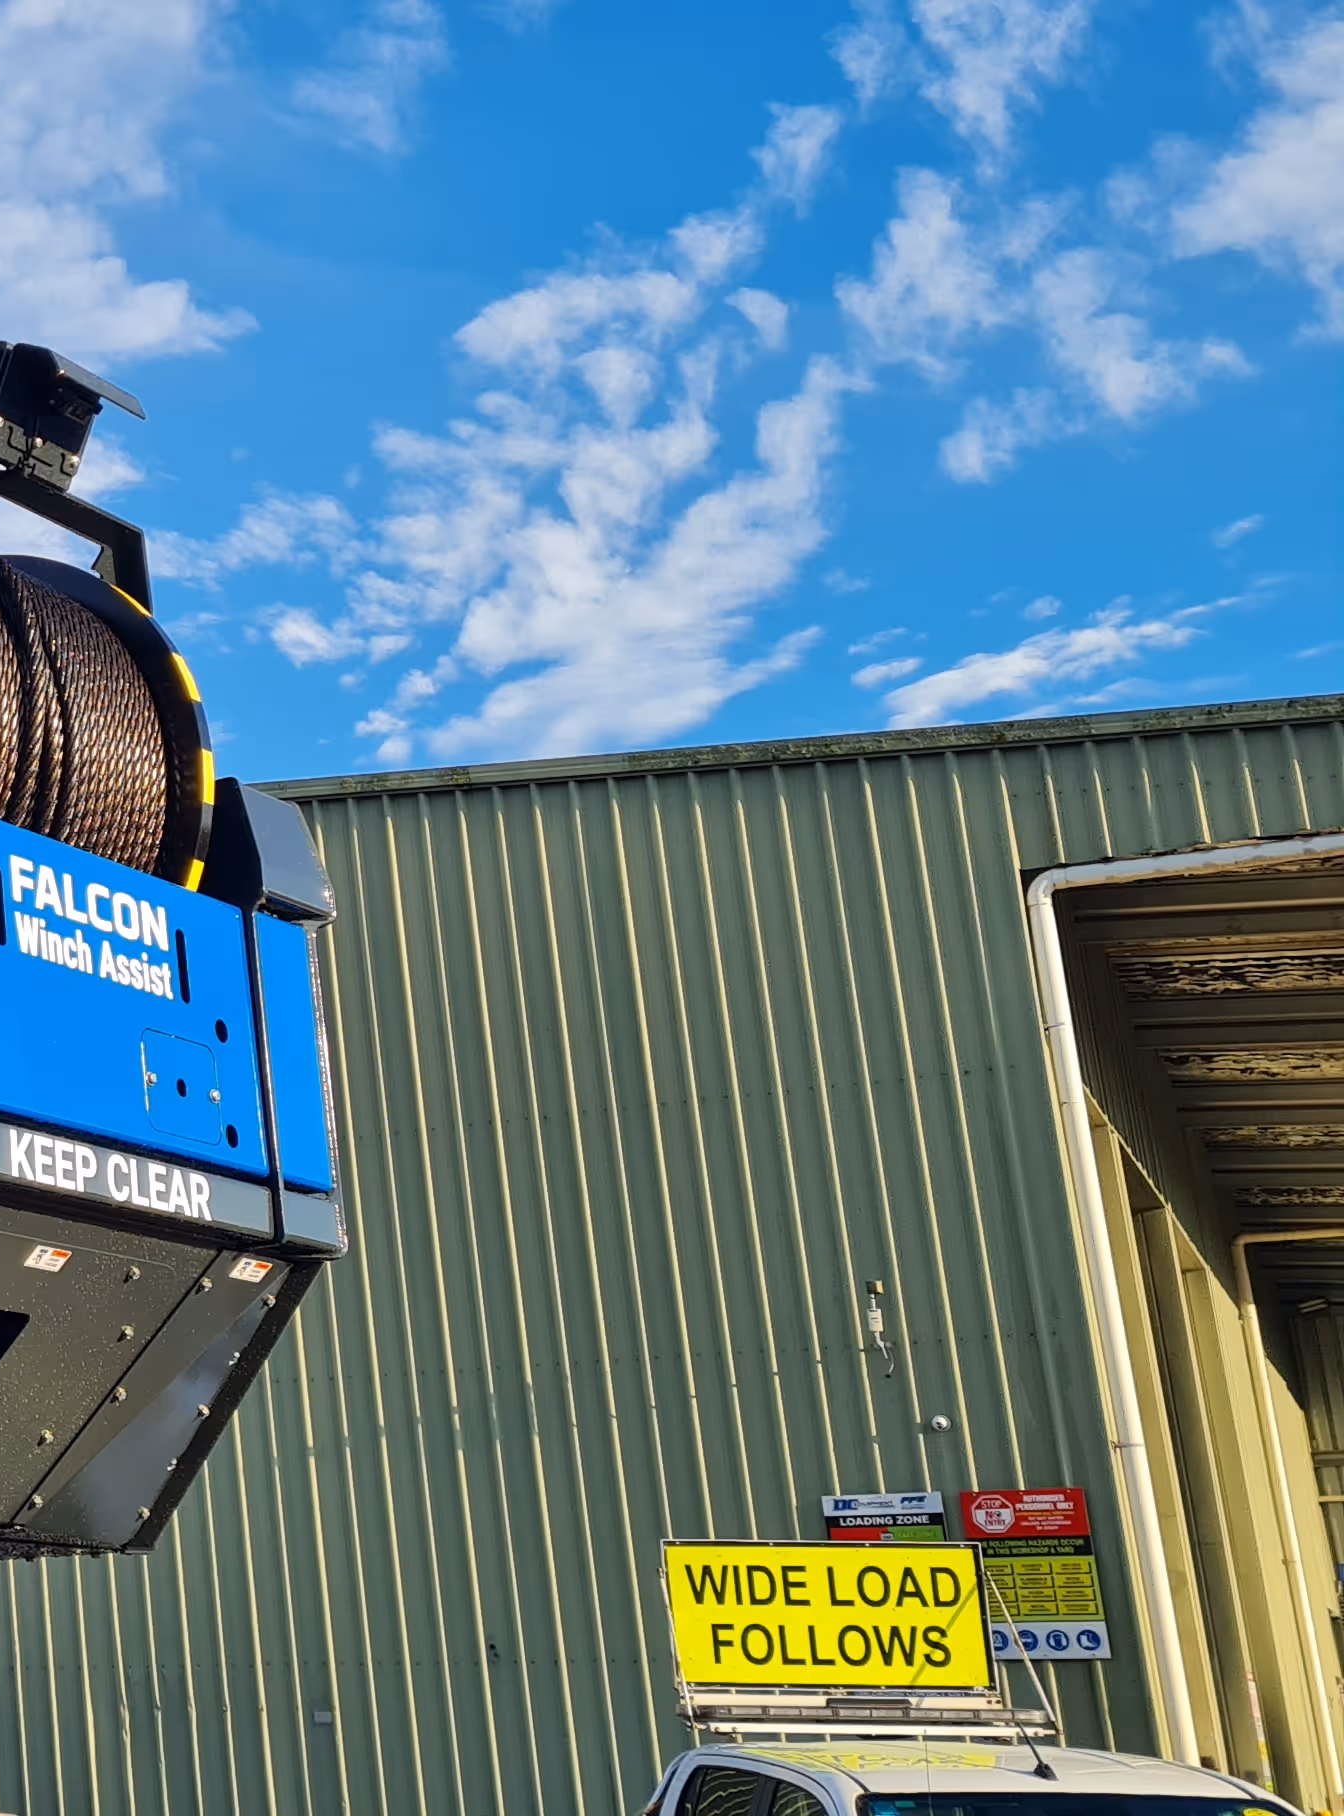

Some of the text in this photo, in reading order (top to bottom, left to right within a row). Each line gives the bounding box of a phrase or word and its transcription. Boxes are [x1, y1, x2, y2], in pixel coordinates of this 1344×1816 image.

[9, 854, 170, 952] FALCON
[14, 911, 175, 1000] Winch Assist
[8, 1128, 214, 1222] KEEP CLEAR
[839, 1515, 930, 1527] LOADING ZONE
[980, 1500, 1003, 1509] STOP
[984, 1518, 1006, 1527] ENTRY
[685, 1565, 810, 1606] WIDE
[827, 1567, 962, 1607] LOAD
[711, 1623, 951, 1667] FOLLOWS
